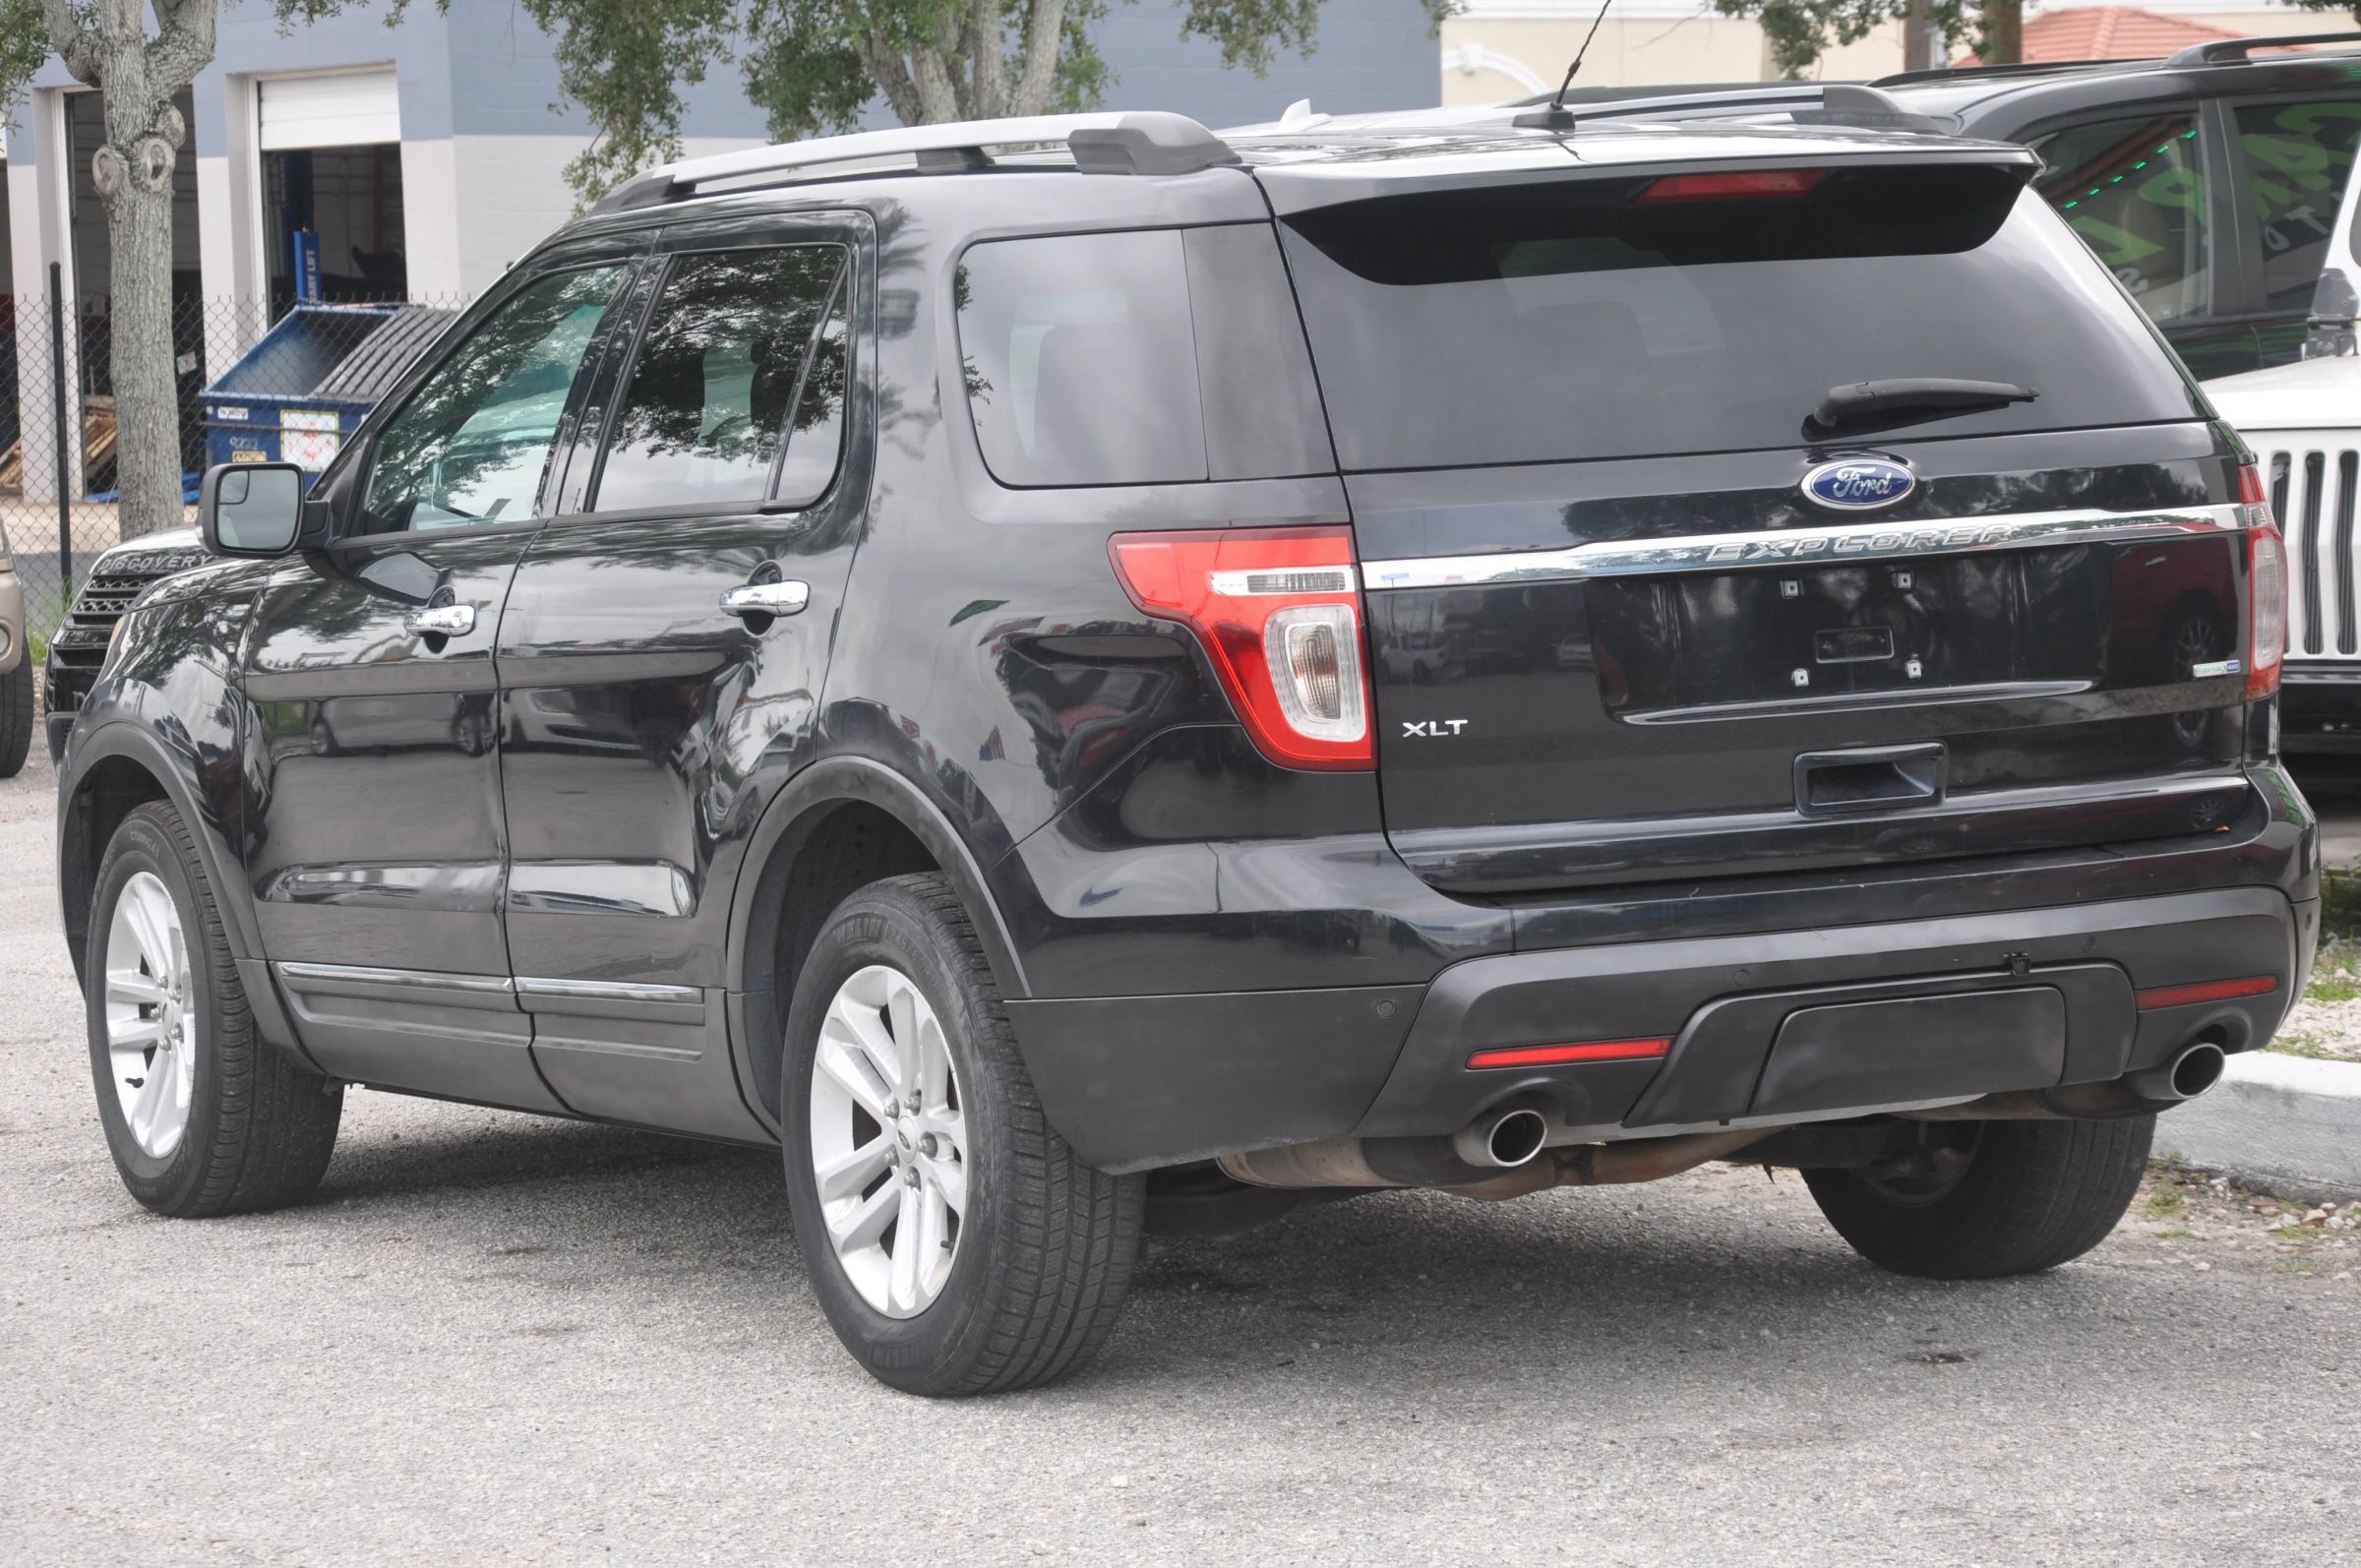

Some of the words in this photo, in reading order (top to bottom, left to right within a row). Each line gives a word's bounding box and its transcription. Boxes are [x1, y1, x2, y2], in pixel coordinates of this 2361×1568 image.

[1833, 467, 1892, 498] Ford
[1705, 523, 2015, 563] EXPLORER
[99, 554, 213, 571] DISCOVERY
[1402, 719, 1469, 738] XLT
